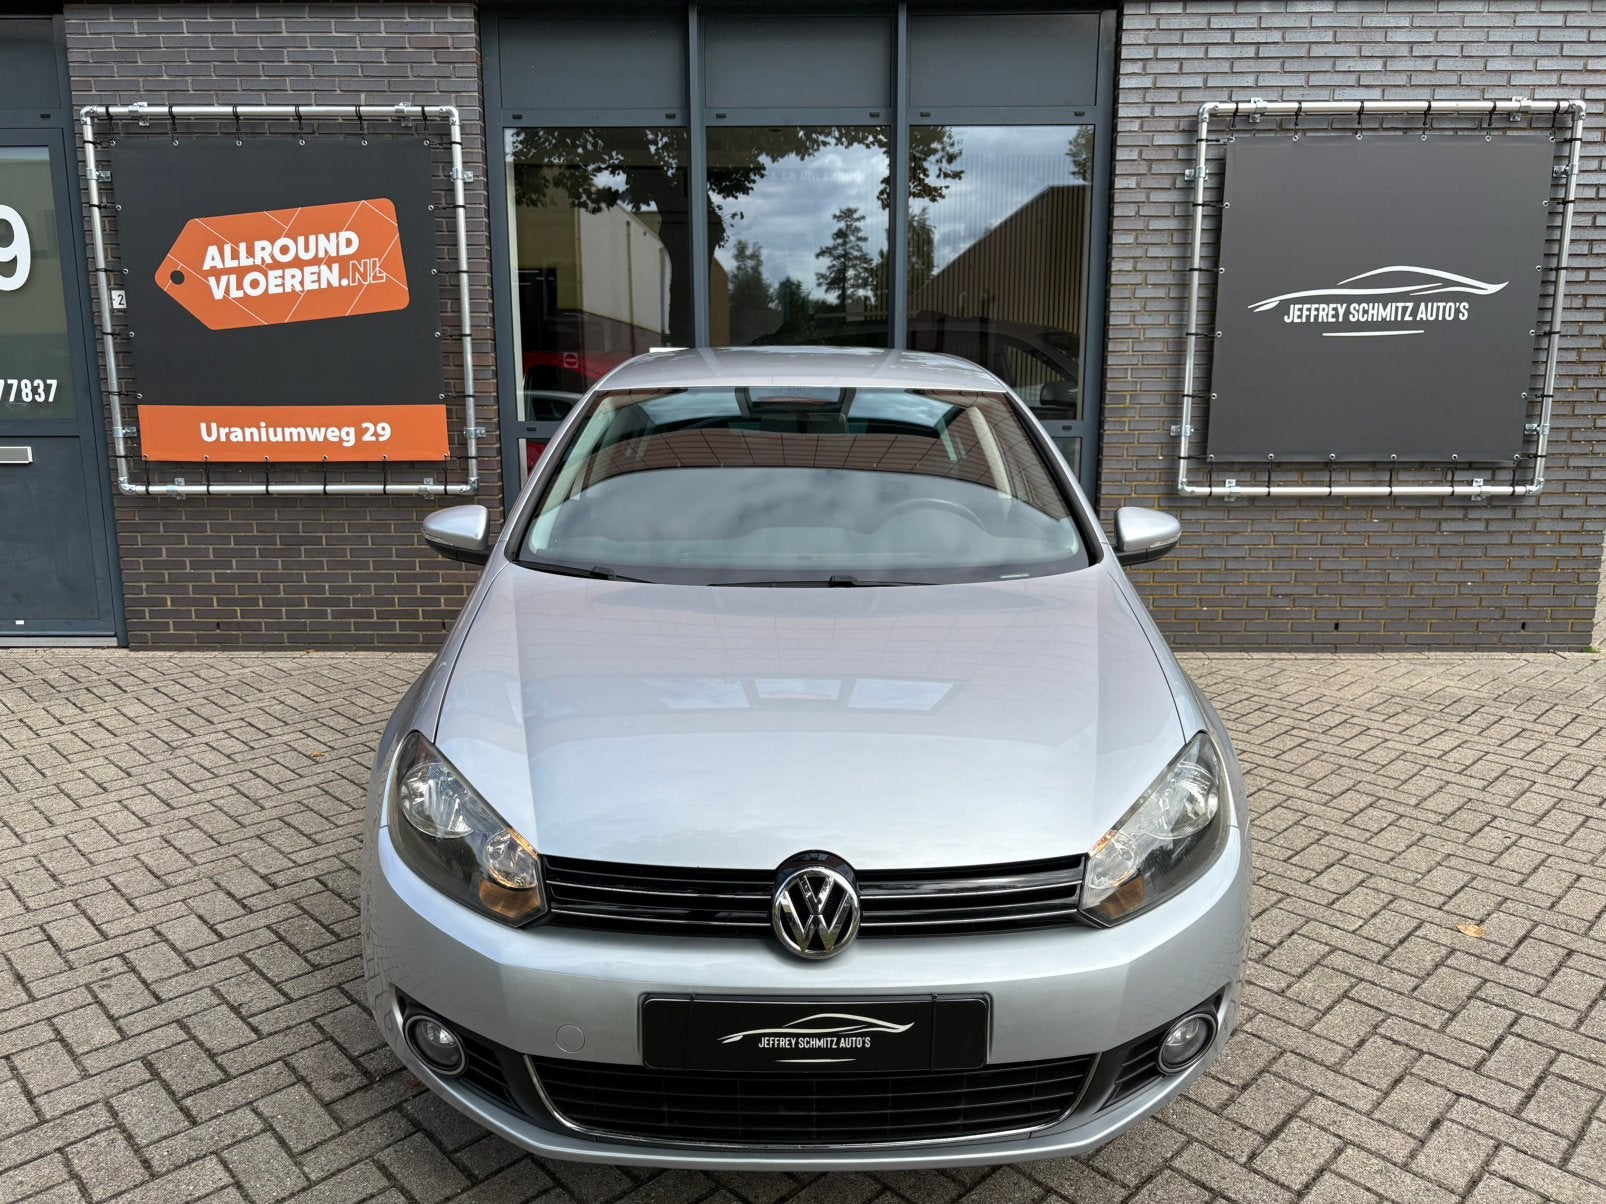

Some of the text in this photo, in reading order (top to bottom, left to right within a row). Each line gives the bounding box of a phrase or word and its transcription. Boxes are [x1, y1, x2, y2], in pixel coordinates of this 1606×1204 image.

[202, 230, 360, 271] ALLROUND
[207, 257, 386, 301] VLOEREN.NL
[1283, 301, 1470, 324] JEFFREY SCHMITZ AUTO'S
[200, 421, 392, 447] Uraniumweg 29
[758, 1036, 872, 1049] JEFFREY SCHMITZ AUTO'S
